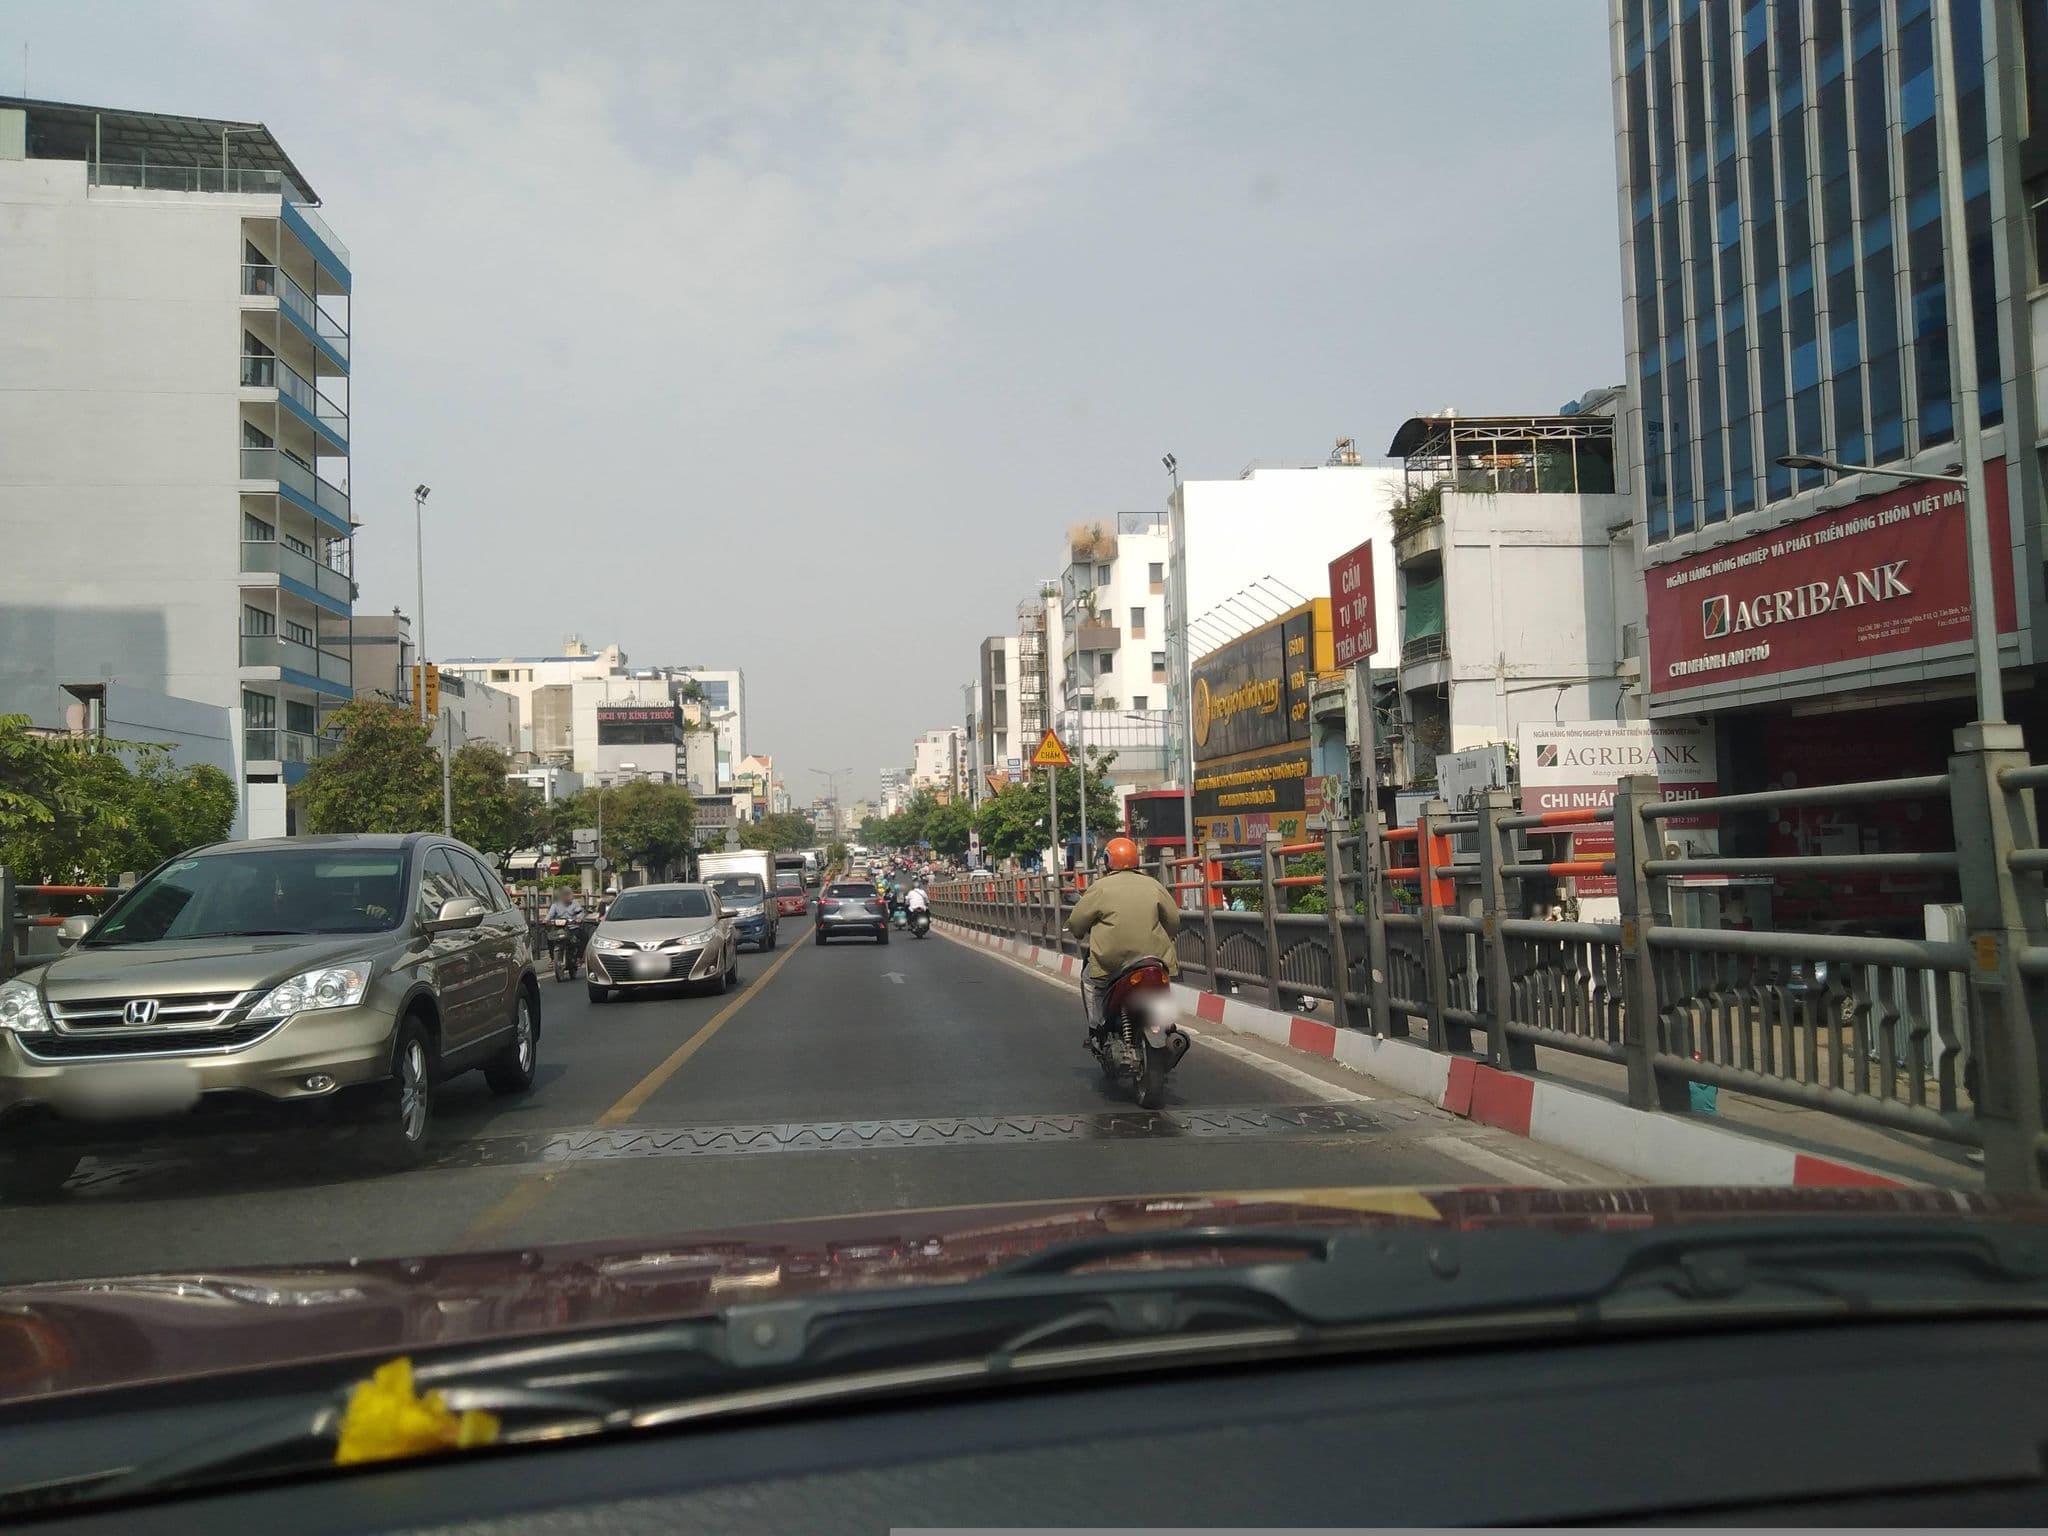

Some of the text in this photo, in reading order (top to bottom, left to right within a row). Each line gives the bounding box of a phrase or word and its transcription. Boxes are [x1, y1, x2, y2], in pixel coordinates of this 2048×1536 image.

[1666, 570, 1688, 589] NGÂN
[1689, 563, 1711, 581] HÀNG
[1712, 555, 1736, 575] NÔNG
[1736, 546, 1769, 569] NGHIỆP
[1770, 540, 1785, 558] VÀ
[1786, 533, 1812, 554] PHÁT
[1814, 520, 1844, 545] TRIỂN
[1845, 514, 1876, 536] NÔNG
[1877, 503, 1910, 524] THÔN
[1912, 494, 1941, 519] VIỆT
[1342, 556, 1361, 594] CẤM
[1733, 559, 1913, 634] AGRIBANK
[1669, 640, 1770, 678] CHI NHÁNH AN PHÚ
[1563, 744, 1700, 767] AGRIBANK
[1540, 793, 1569, 809] CHI
[1573, 789, 1615, 808] NHÁN
